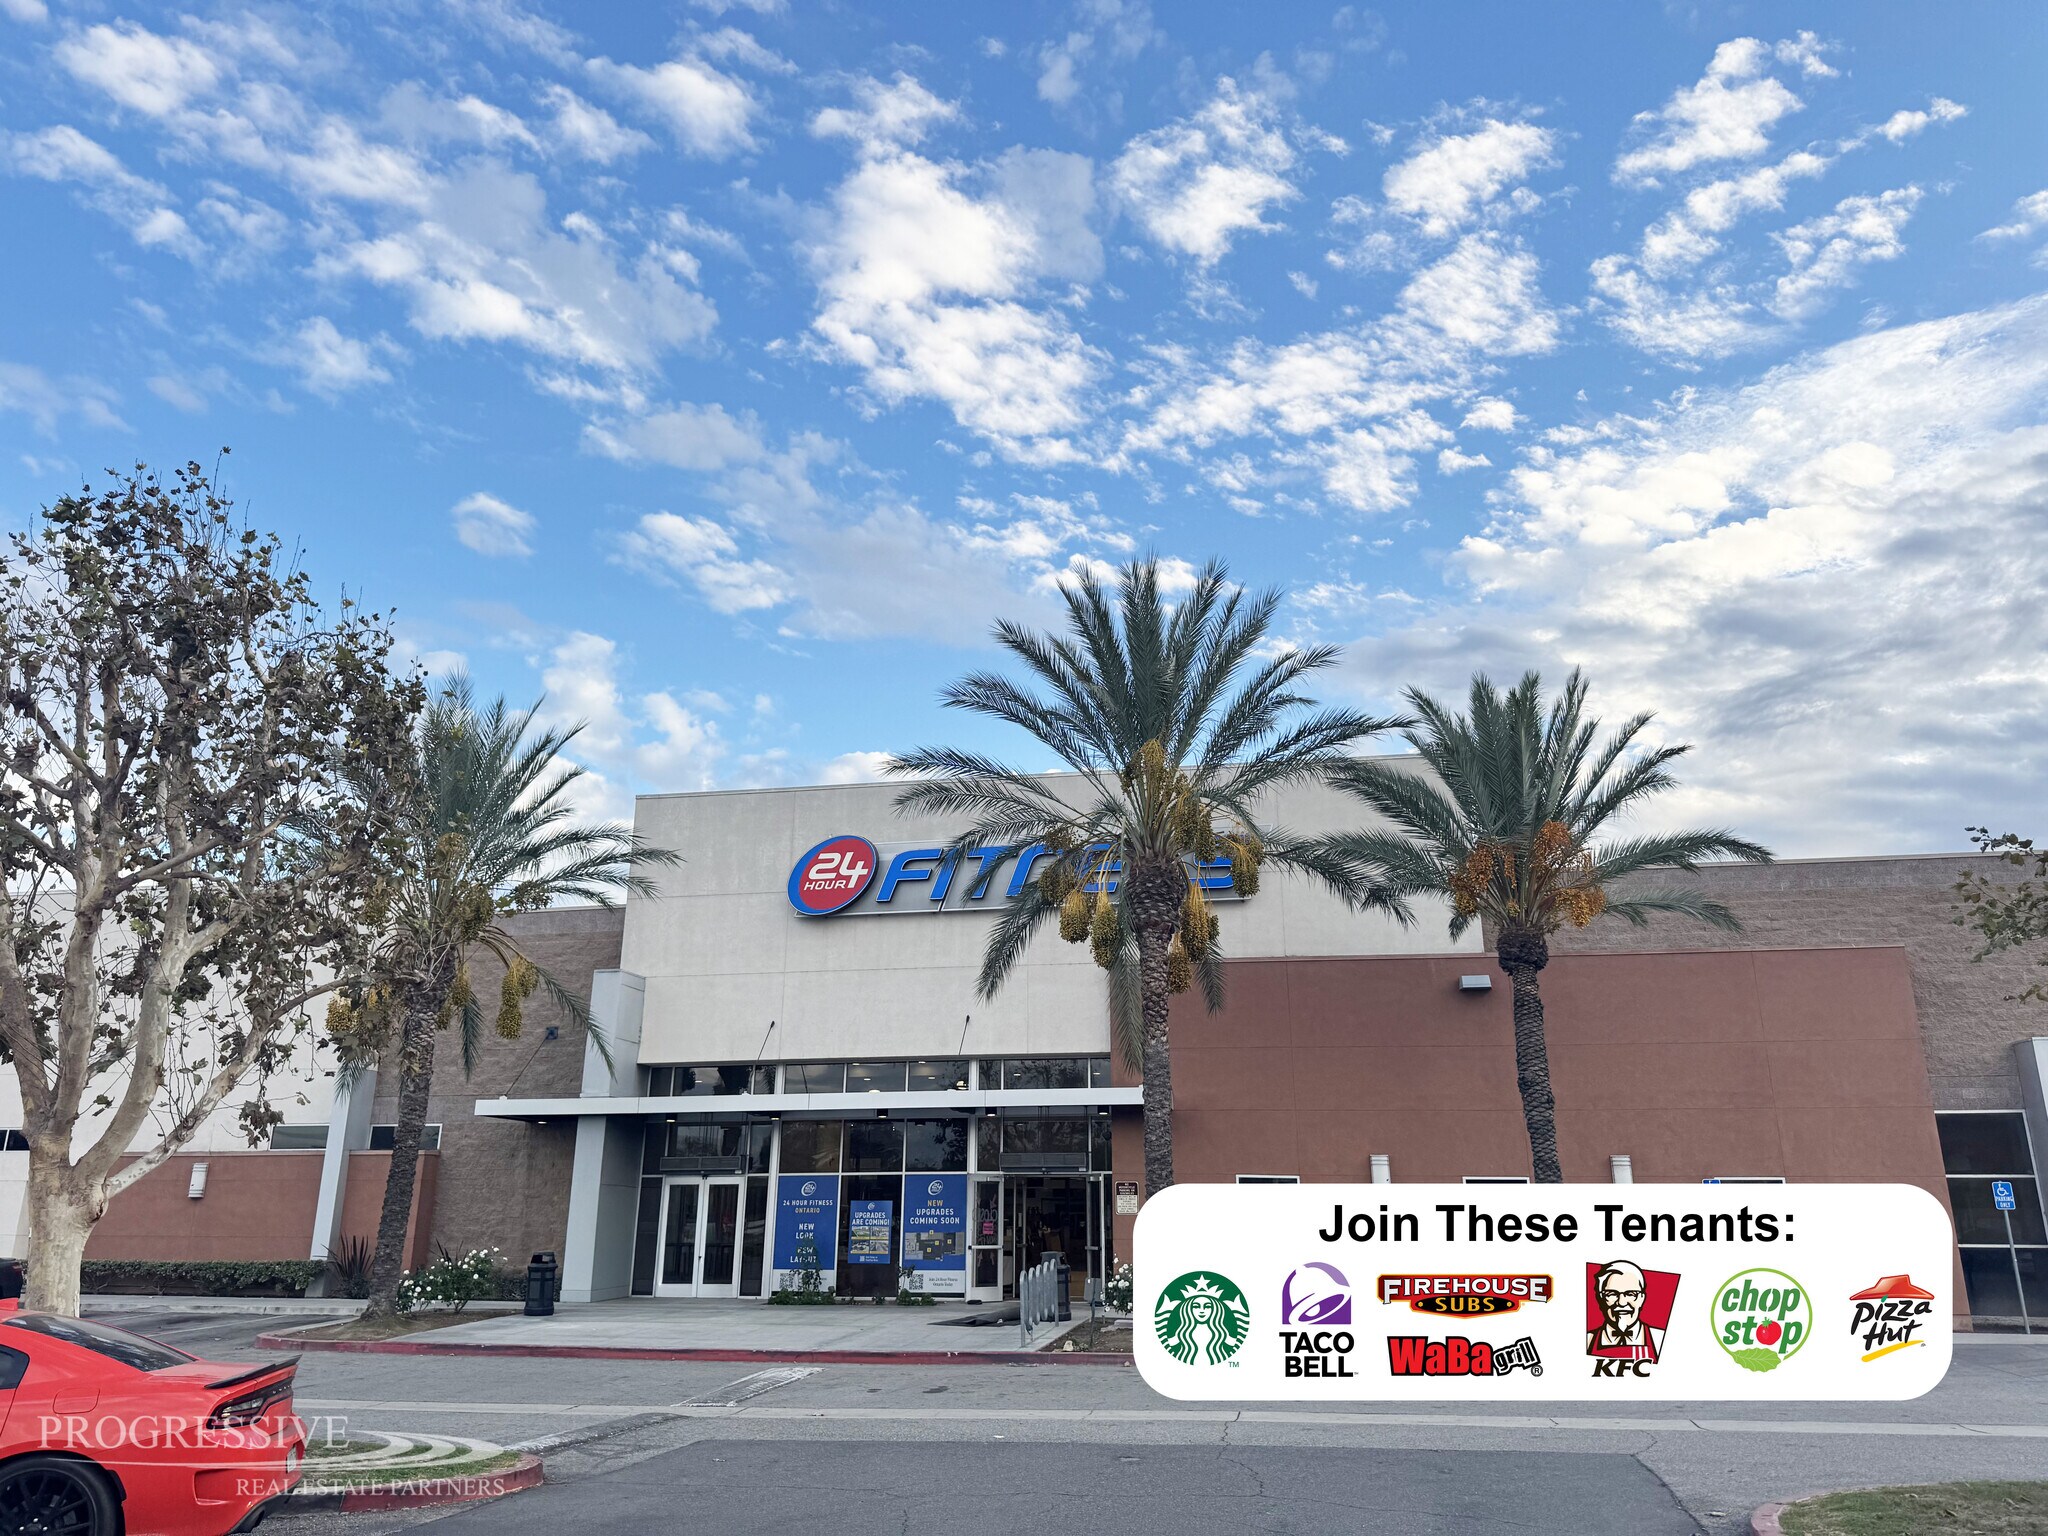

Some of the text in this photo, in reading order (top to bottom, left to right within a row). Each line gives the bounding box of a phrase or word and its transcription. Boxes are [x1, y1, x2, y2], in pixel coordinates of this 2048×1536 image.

[804, 880, 846, 890] HOUR
[808, 852, 868, 888] 24
[876, 839, 1243, 902] FITNES
